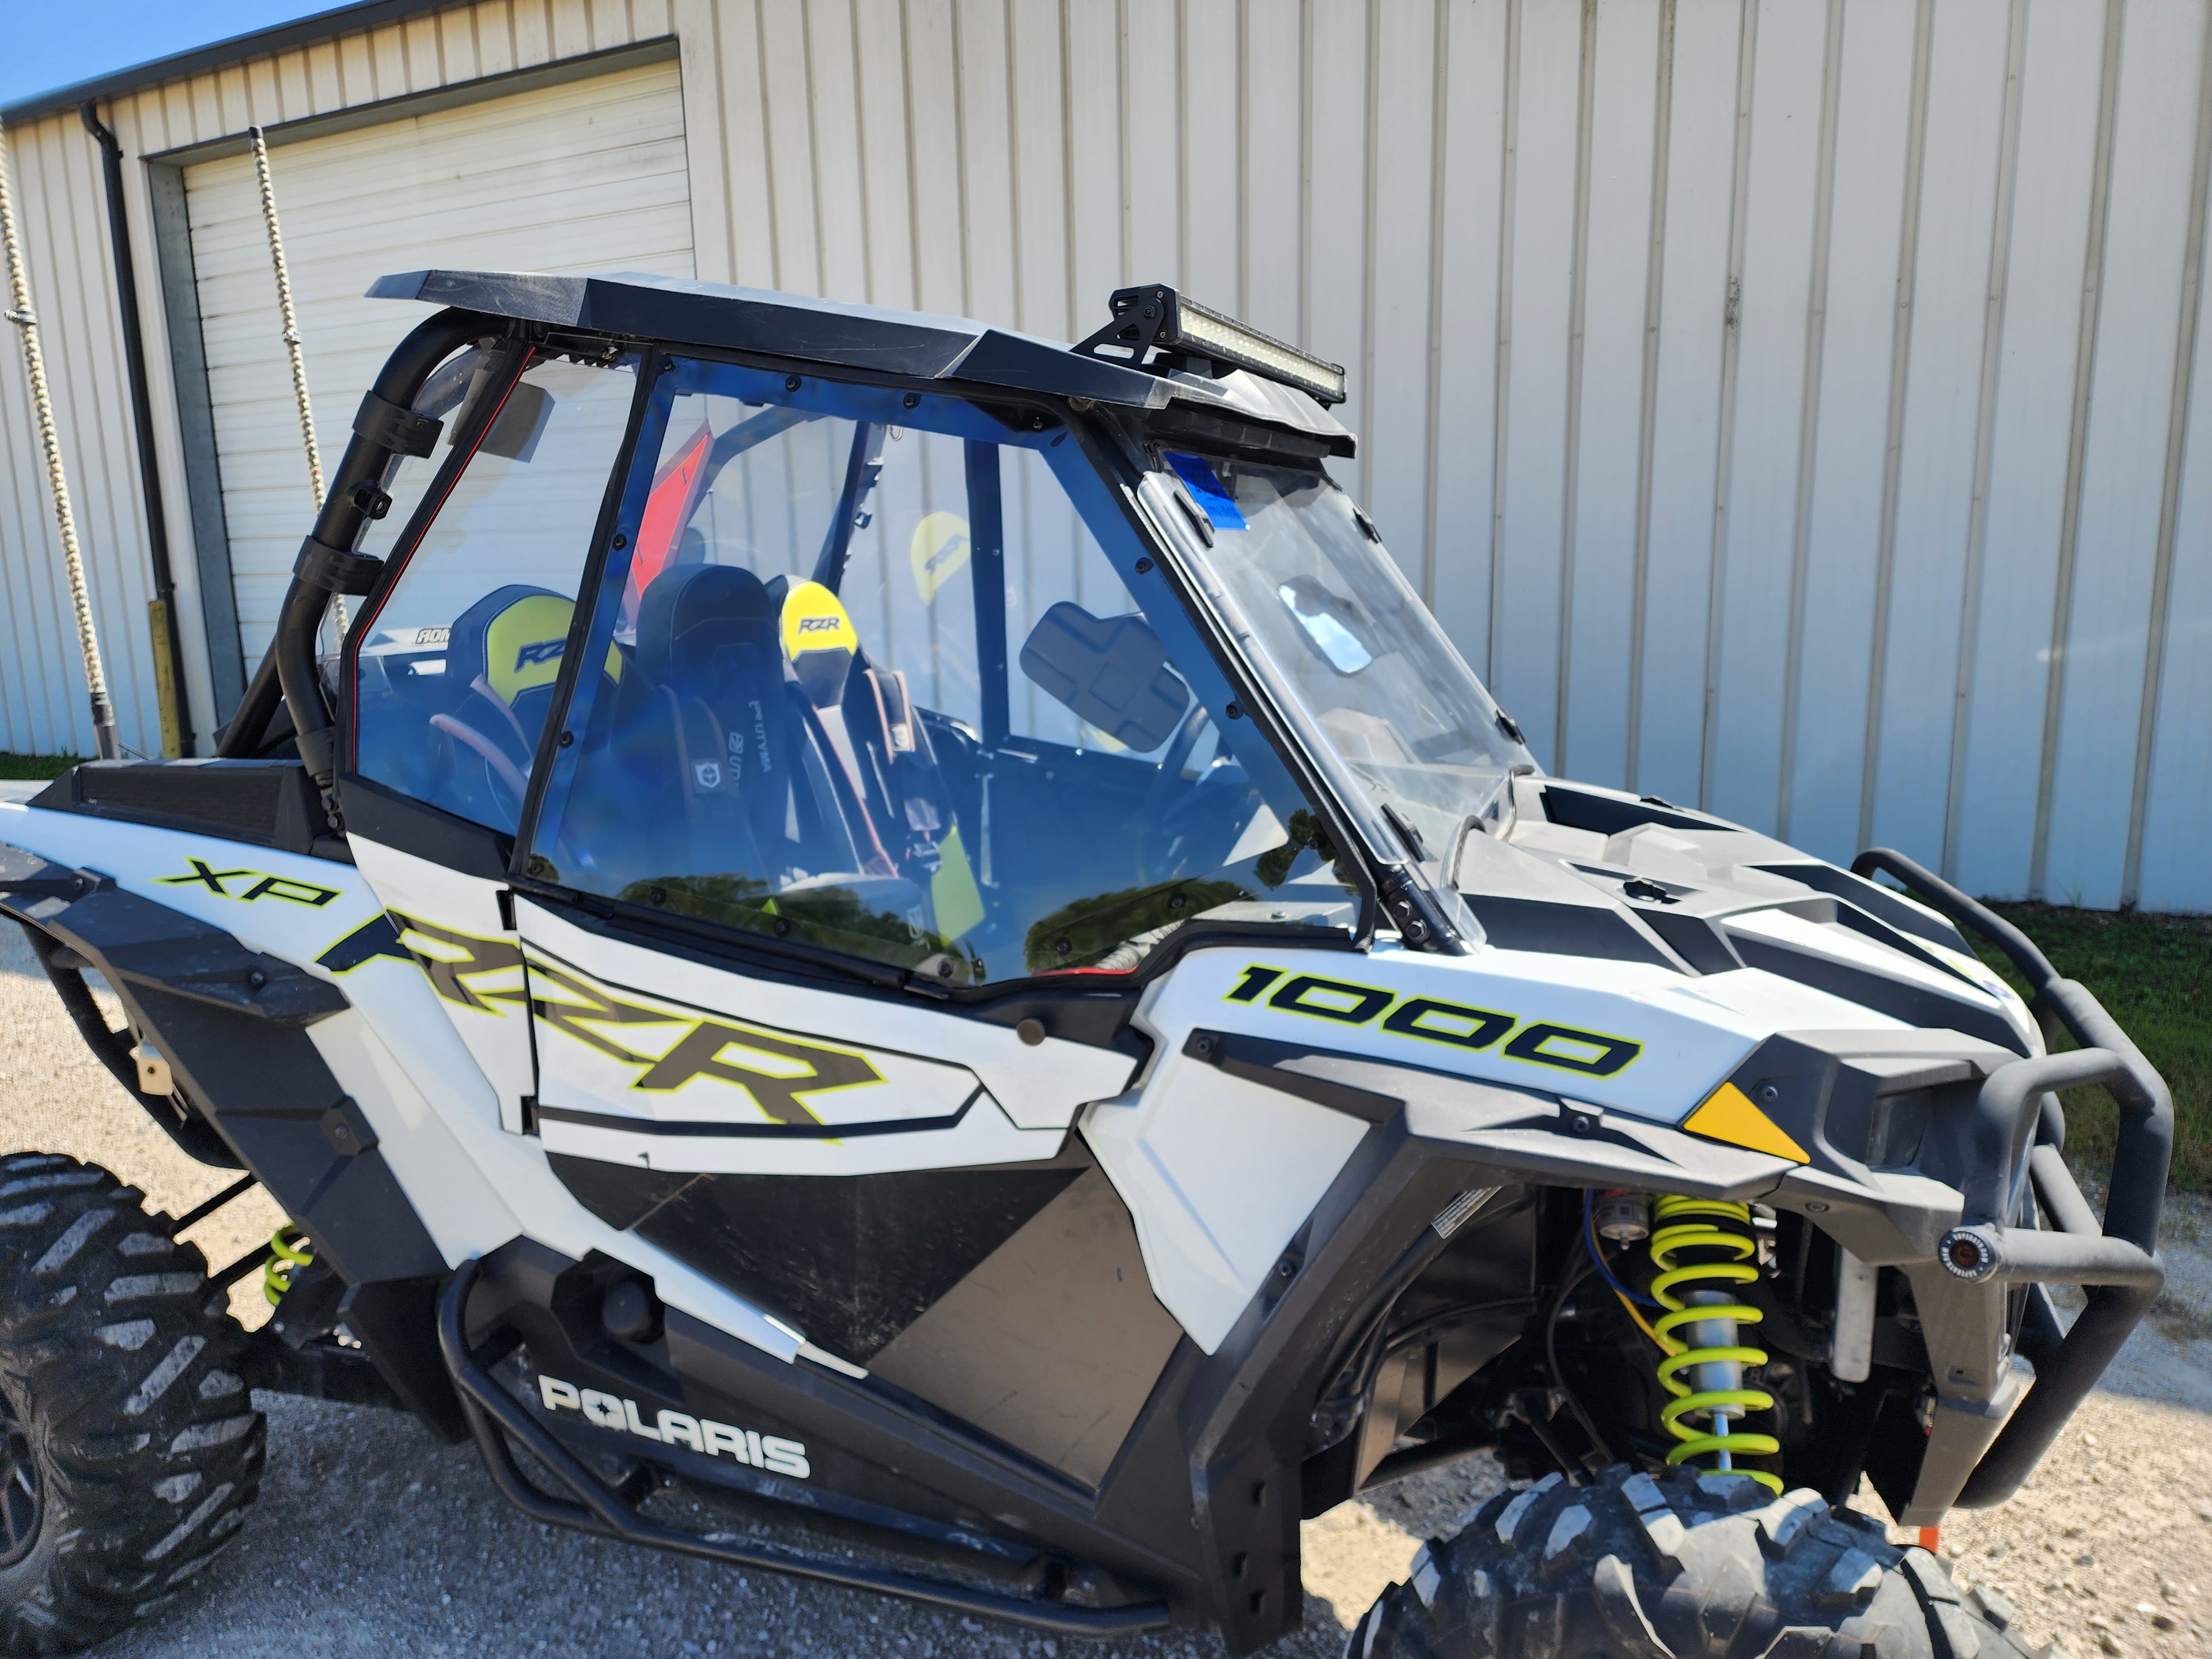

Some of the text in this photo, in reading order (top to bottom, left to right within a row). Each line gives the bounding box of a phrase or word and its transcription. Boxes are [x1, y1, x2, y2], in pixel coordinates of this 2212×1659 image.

[514, 637, 567, 674] RZ
[798, 617, 840, 635] RZR
[149, 857, 343, 908] XP
[315, 907, 889, 1146] RZR
[1222, 963, 1644, 1079] 1000
[538, 1374, 810, 1479] POLARIS
